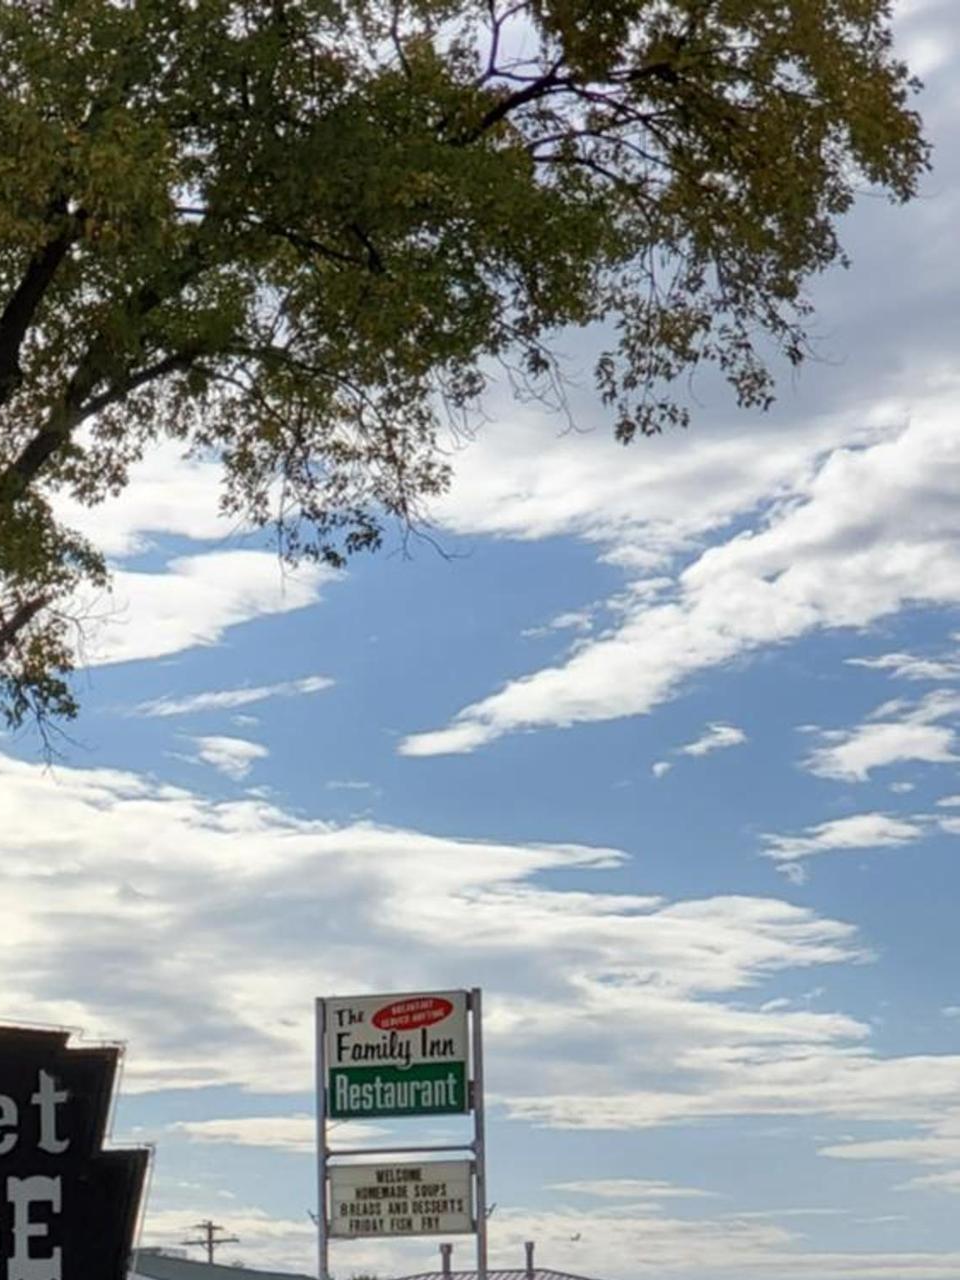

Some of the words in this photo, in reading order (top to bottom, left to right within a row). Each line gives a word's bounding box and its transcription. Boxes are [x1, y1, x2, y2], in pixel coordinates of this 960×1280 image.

[334, 1008, 364, 1027] The
[337, 1031, 410, 1066] Family
[421, 1028, 454, 1057] Inn
[335, 1073, 458, 1111] Restaurant
[376, 1168, 422, 1183] WELCOME
[355, 1186, 408, 1199] HOMEMADE
[414, 1183, 447, 1197] SOUPS
[388, 1201, 409, 1215] AND
[411, 1199, 463, 1215] DESSERTS
[349, 1218, 385, 1232] FRIDAY
[390, 1218, 413, 1231] FISH
[421, 1216, 440, 1230] FRY
